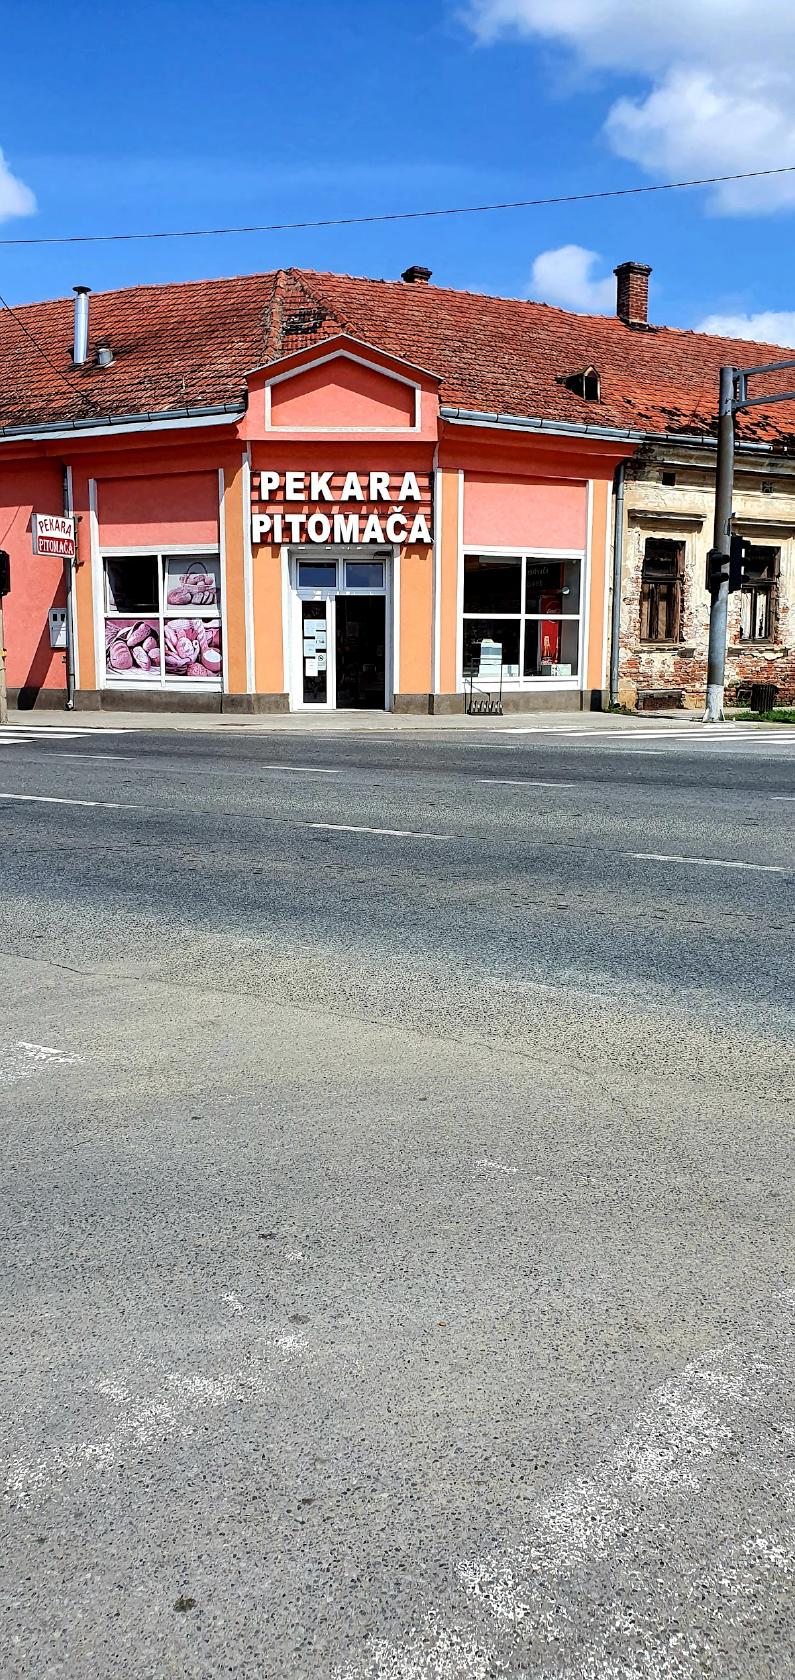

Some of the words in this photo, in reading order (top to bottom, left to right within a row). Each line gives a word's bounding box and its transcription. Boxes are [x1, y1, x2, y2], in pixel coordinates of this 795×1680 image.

[260, 471, 422, 501] PEKARA
[38, 518, 72, 537] PEKARA
[252, 505, 432, 543] PITOMAČA
[39, 539, 74, 555] PITOMAČA
